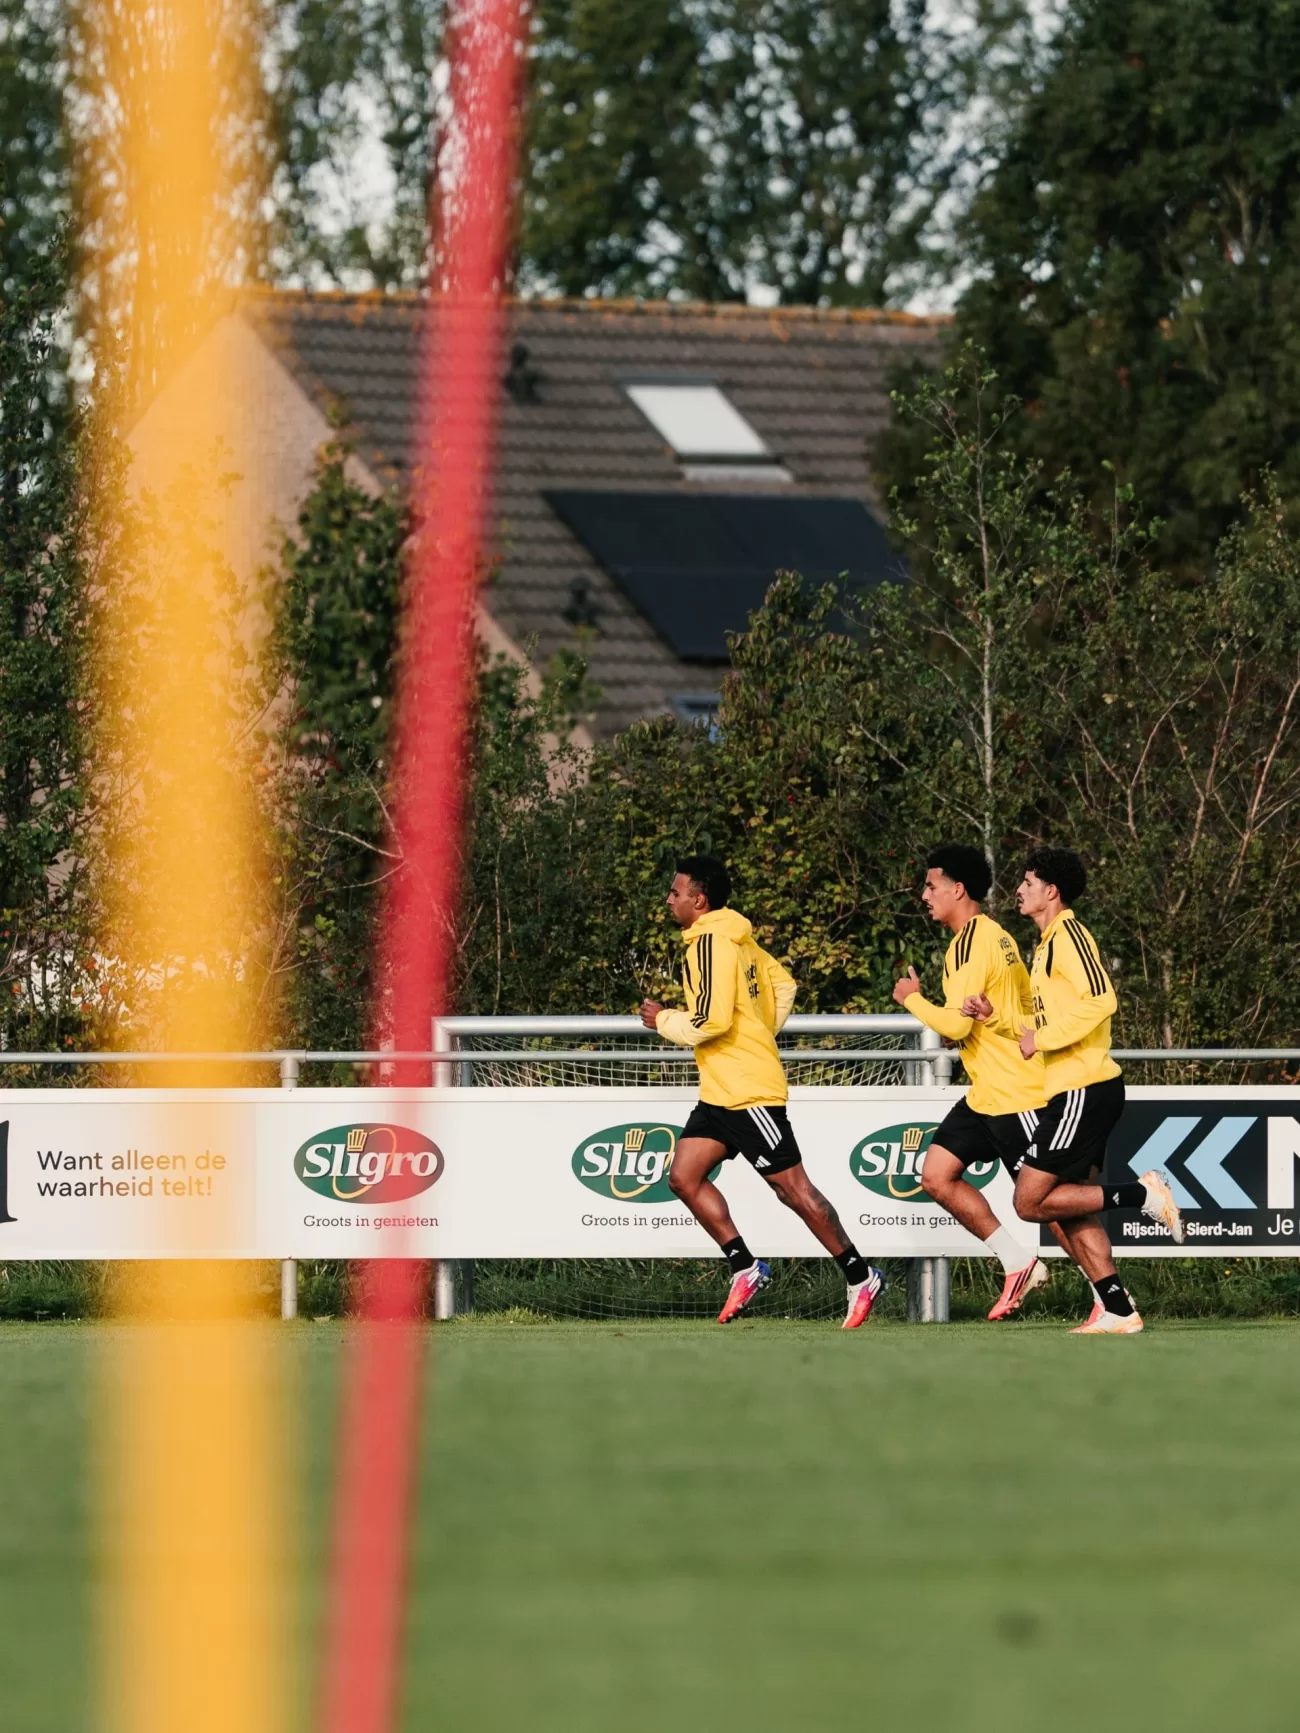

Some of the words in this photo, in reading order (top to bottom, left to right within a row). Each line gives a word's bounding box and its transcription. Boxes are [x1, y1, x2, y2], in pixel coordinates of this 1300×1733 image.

[36, 1150, 103, 1171] Want
[111, 1149, 187, 1171] alleen
[194, 1149, 227, 1171] de
[302, 1143, 438, 1185] Sligro
[580, 1142, 675, 1185] Slig
[36, 1175, 153, 1197] waarheid
[161, 1175, 213, 1197] telt!
[303, 1215, 352, 1227] Groots
[355, 1215, 370, 1227] in
[374, 1215, 439, 1230] genieten
[581, 1214, 630, 1226] Groots
[634, 1214, 648, 1226] in
[651, 1214, 698, 1229] geniet
[859, 1213, 908, 1226] Groots
[911, 1213, 926, 1226] in
[1123, 1222, 1185, 1239] Rijscho
[1186, 1222, 1253, 1236] Sierd-Jan
[1267, 1214, 1294, 1236] Je
